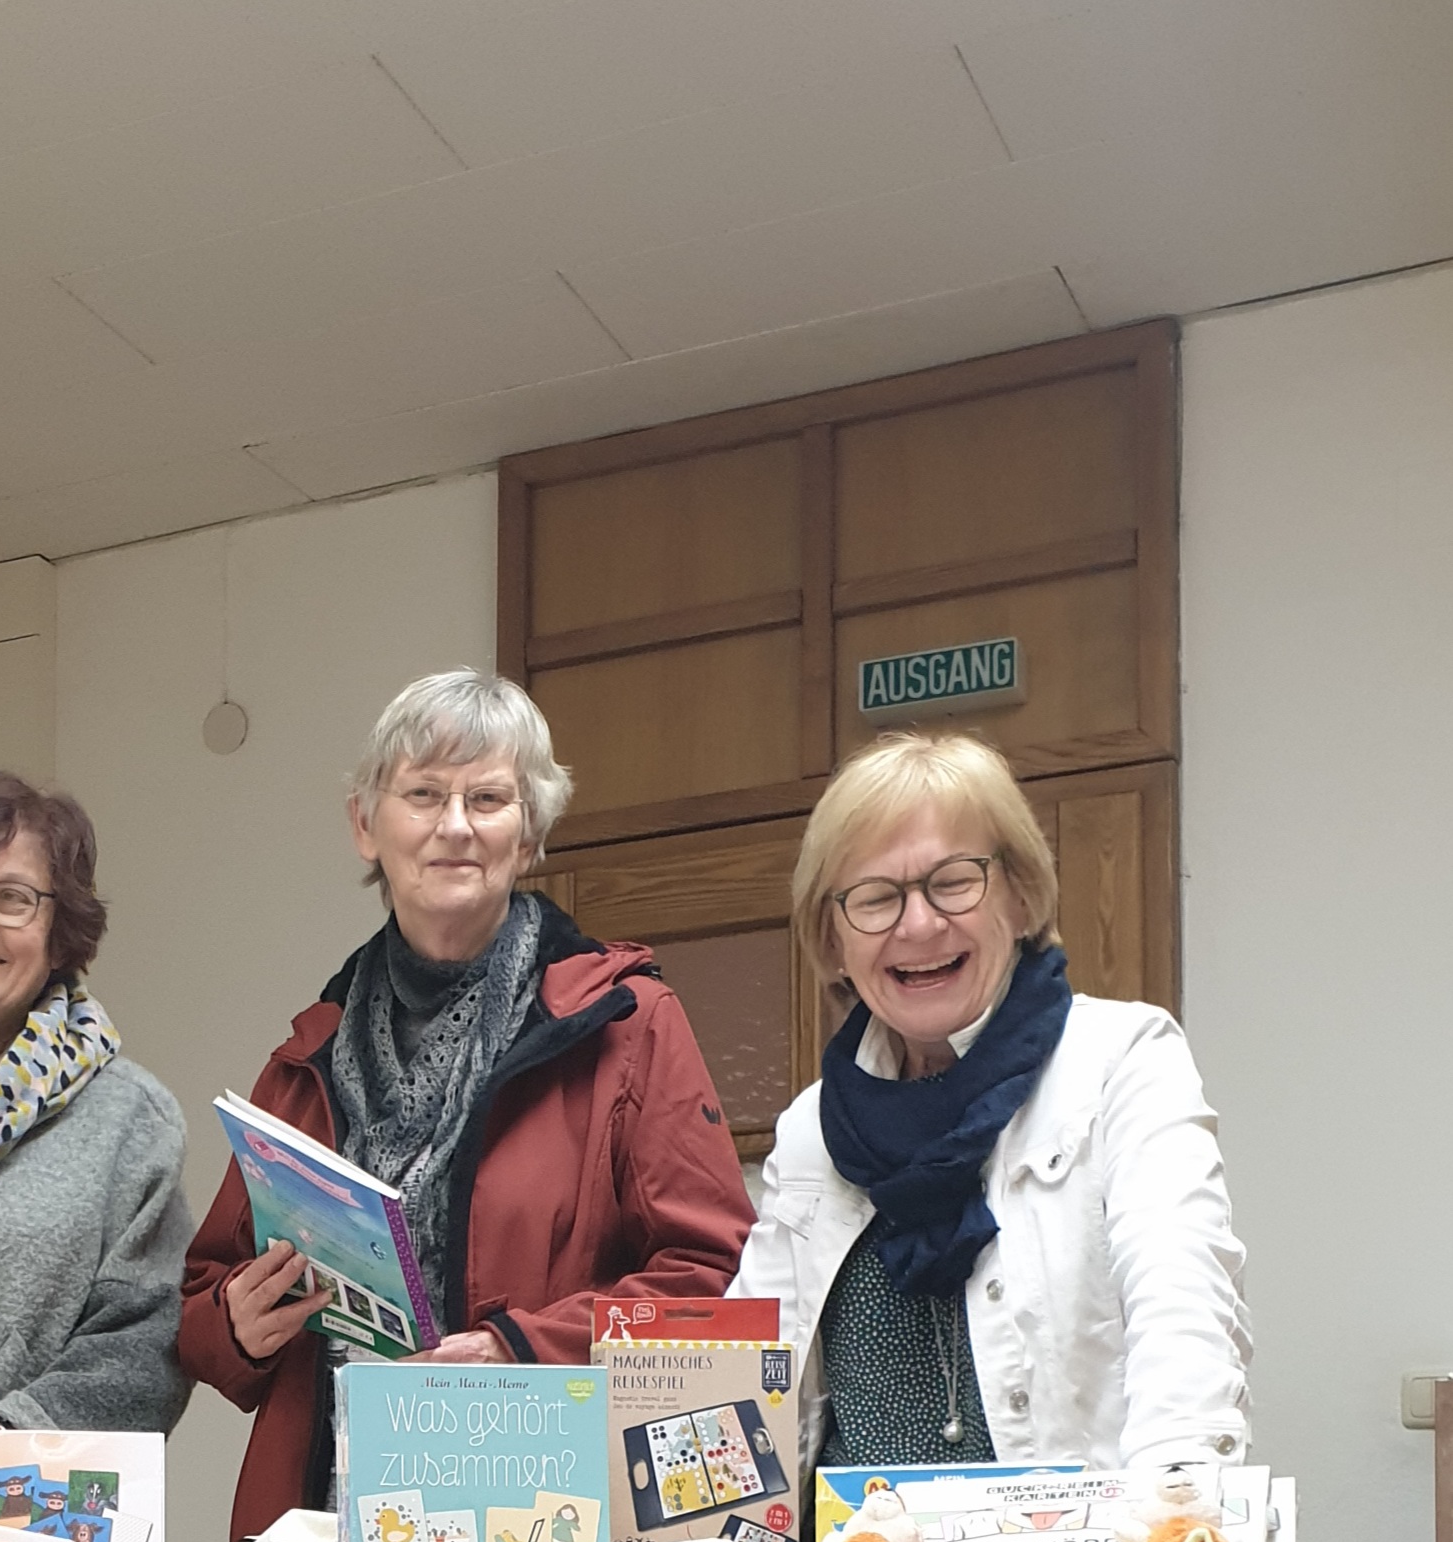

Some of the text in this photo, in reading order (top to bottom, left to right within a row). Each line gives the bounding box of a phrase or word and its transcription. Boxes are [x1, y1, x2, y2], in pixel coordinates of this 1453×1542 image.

[866, 643, 1011, 706] AUSGANG
[613, 1355, 713, 1370] MAGNETISCHES
[421, 1377, 450, 1388] Mein
[613, 1375, 685, 1389] REISESPIEL
[386, 1393, 570, 1446] Was gehört
[380, 1450, 577, 1488] zusammen?
